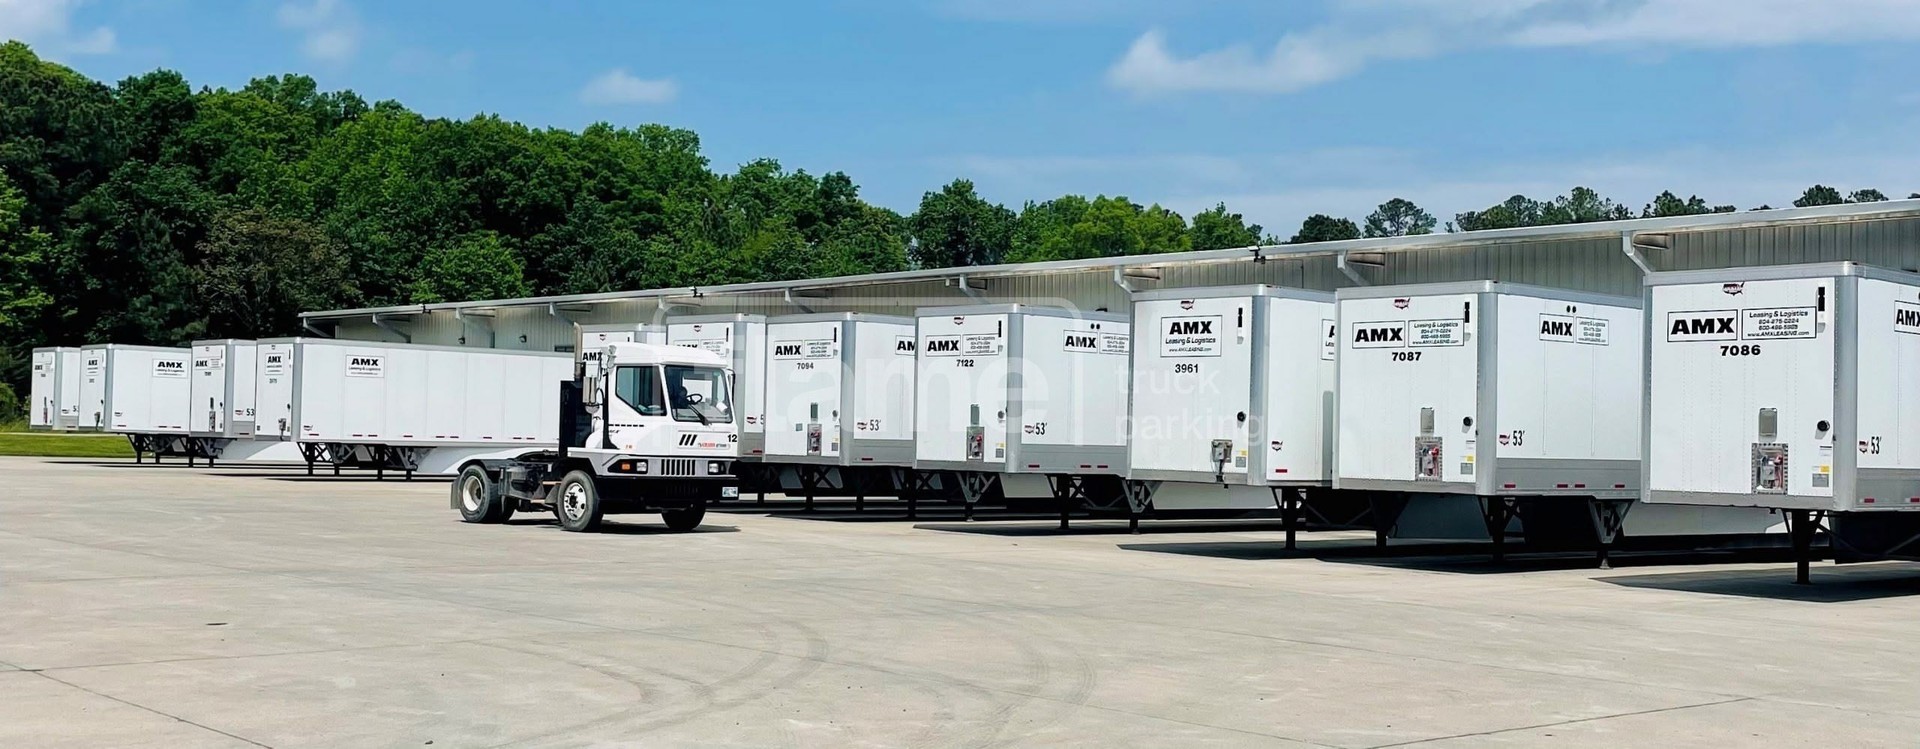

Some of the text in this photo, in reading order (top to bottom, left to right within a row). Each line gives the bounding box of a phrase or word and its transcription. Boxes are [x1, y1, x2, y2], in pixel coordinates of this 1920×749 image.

[1169, 321, 1212, 334] AMX
[1541, 321, 1572, 336] AMX
[1671, 318, 1734, 335] AMX
[1355, 328, 1403, 342] AMX
[897, 341, 915, 351] AM
[928, 340, 959, 351] AMX
[1065, 336, 1096, 348] AMX
[775, 345, 801, 355] AMX
[1720, 345, 1761, 356] 7086
[1392, 352, 1422, 361] 7087
[352, 358, 378, 366] AMX
[956, 359, 974, 367] 7122
[1175, 363, 1198, 373] 3961
[728, 434, 738, 442] 12
